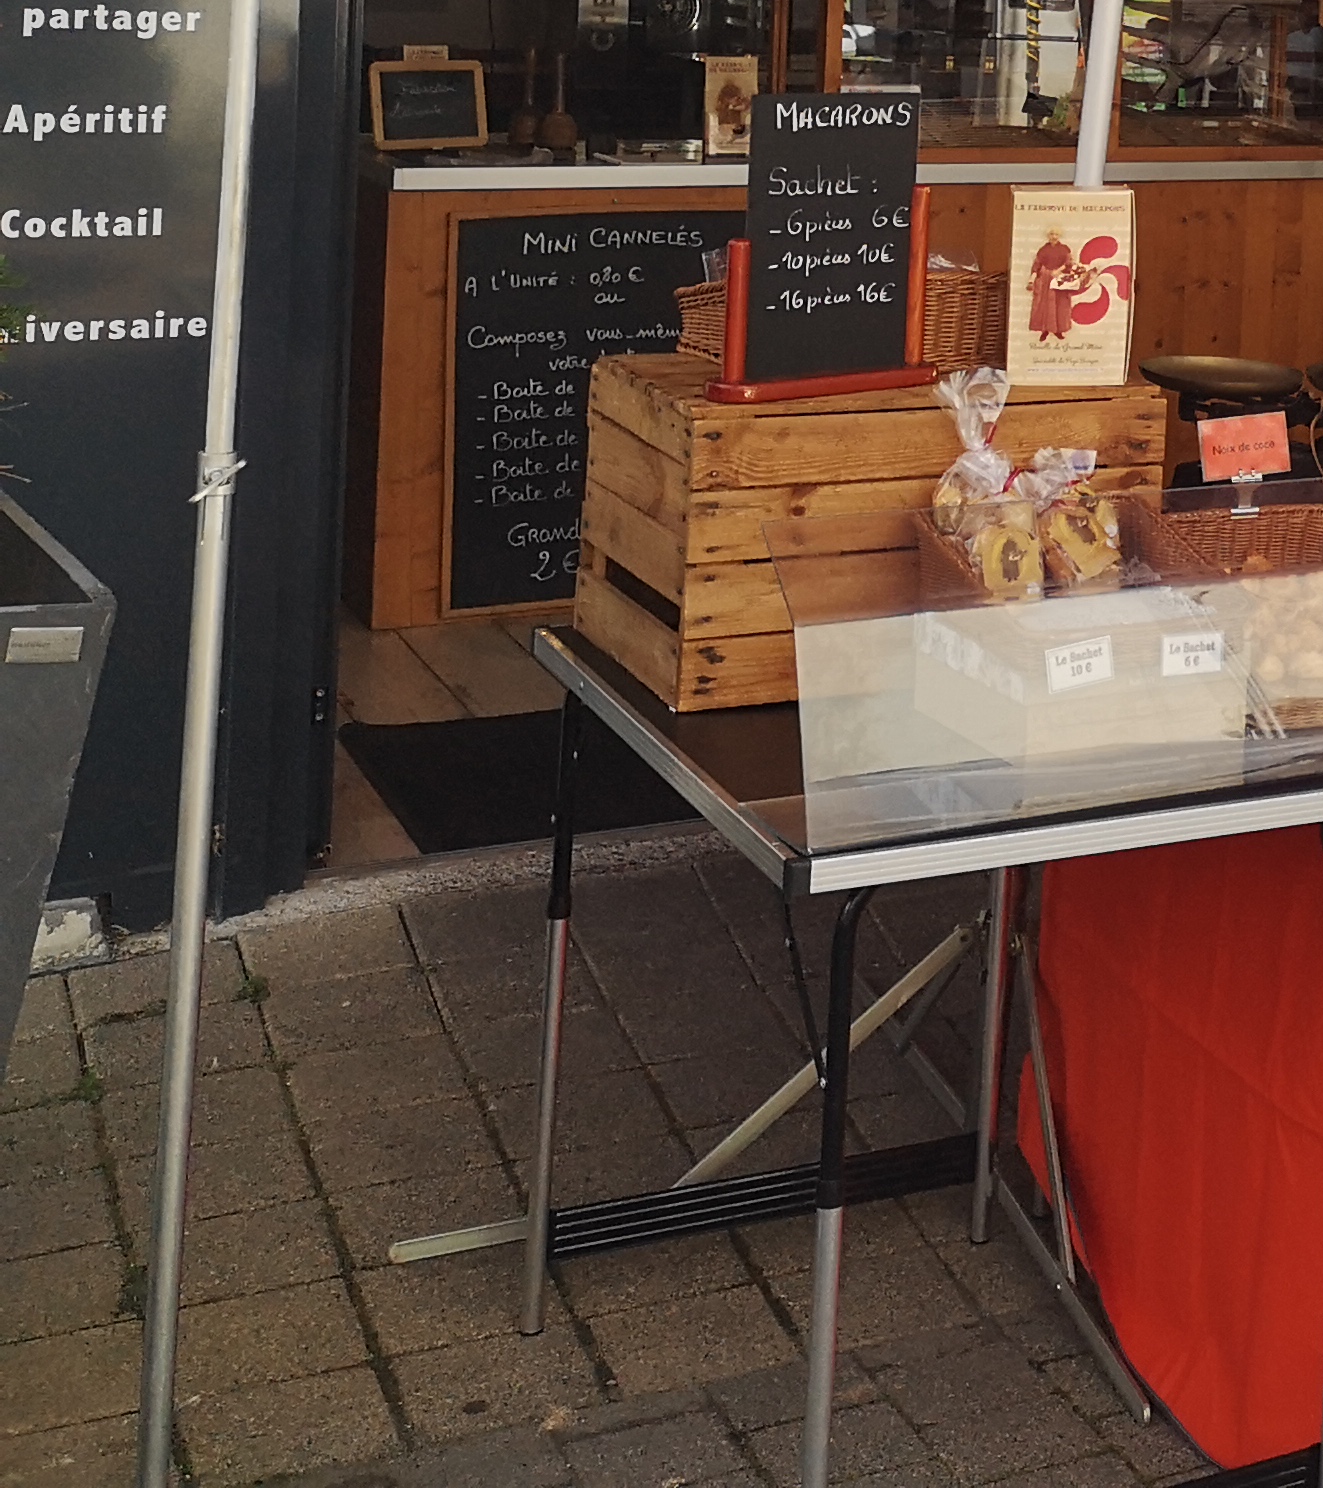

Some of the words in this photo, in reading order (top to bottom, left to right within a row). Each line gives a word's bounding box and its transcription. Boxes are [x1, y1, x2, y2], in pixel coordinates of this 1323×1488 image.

[22, 4, 200, 39] partager
[3, 104, 167, 141] Apéritif
[776, 101, 912, 132] MACARONS
[768, 165, 859, 196] Sachet
[1, 208, 163, 238] Cocktail
[589, 225, 704, 249] CANNELÉS
[467, 326, 568, 357] Composez
[586, 326, 684, 342] vous-mêm
[555, 380, 575, 395] de
[1212, 445, 1235, 456] Noix
[1238, 443, 1250, 453] de
[1253, 440, 1275, 451] coco
[1055, 655, 1067, 667] Le
[1070, 646, 1103, 663] Sachet
[1169, 643, 1181, 654] Le
[1183, 641, 1216, 654] Sachet
[1071, 665, 1083, 677] 10
[1085, 663, 1092, 674] €
[1193, 656, 1200, 667] €
